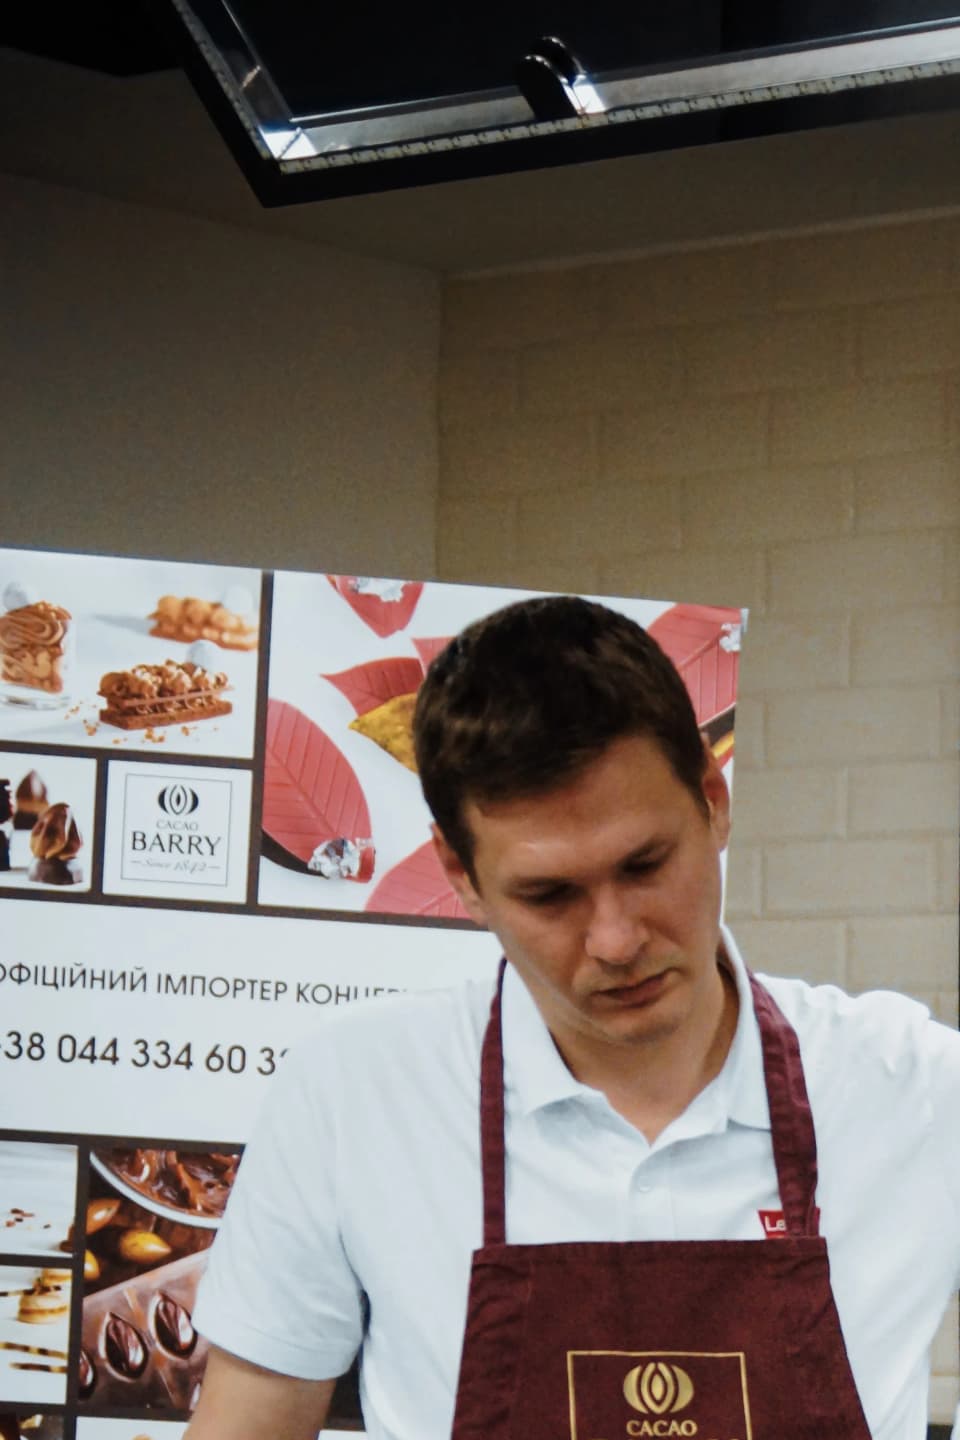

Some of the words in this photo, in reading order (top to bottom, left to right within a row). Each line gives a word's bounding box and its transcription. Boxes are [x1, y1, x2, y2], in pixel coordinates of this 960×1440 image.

[155, 819, 199, 832] CACAO
[131, 830, 221, 857] BARRY
[156, 973, 288, 1002] ІМПОРТЕР
[0, 1030, 46, 1061] 38
[57, 1034, 119, 1066] 044
[131, 1039, 193, 1071] 334
[205, 1043, 246, 1074] 60
[626, 1420, 698, 1437] CACAO
